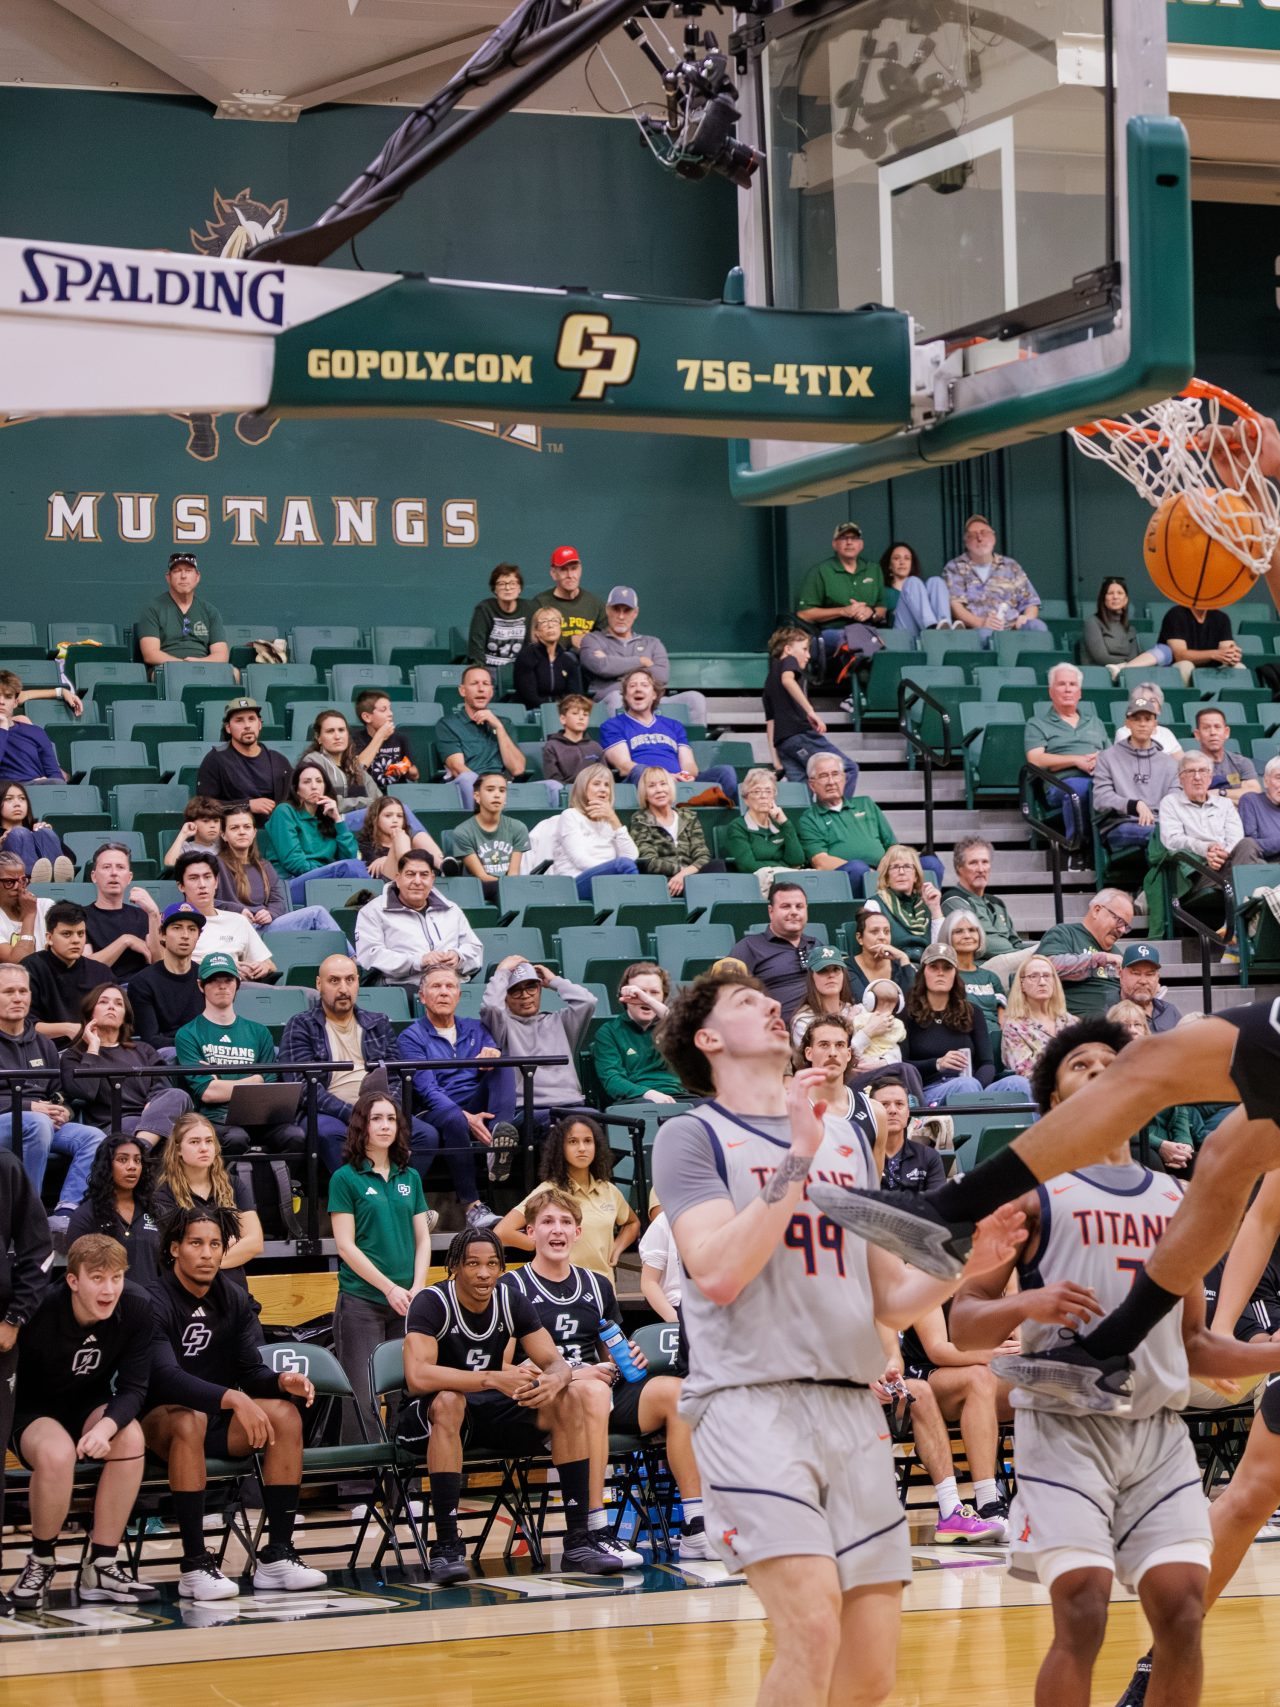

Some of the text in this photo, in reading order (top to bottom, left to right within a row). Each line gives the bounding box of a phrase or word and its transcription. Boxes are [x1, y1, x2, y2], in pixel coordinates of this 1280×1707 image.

[20, 248, 285, 327] SPALDING
[307, 348, 533, 384] GOPOLY.COM
[676, 359, 874, 397] 756-4TIX
[46, 492, 480, 547] MUSTANGS
[202, 1044, 254, 1059] MUSTANG
[784, 1213, 846, 1278] 99
[1072, 1209, 1173, 1248] TITAN
